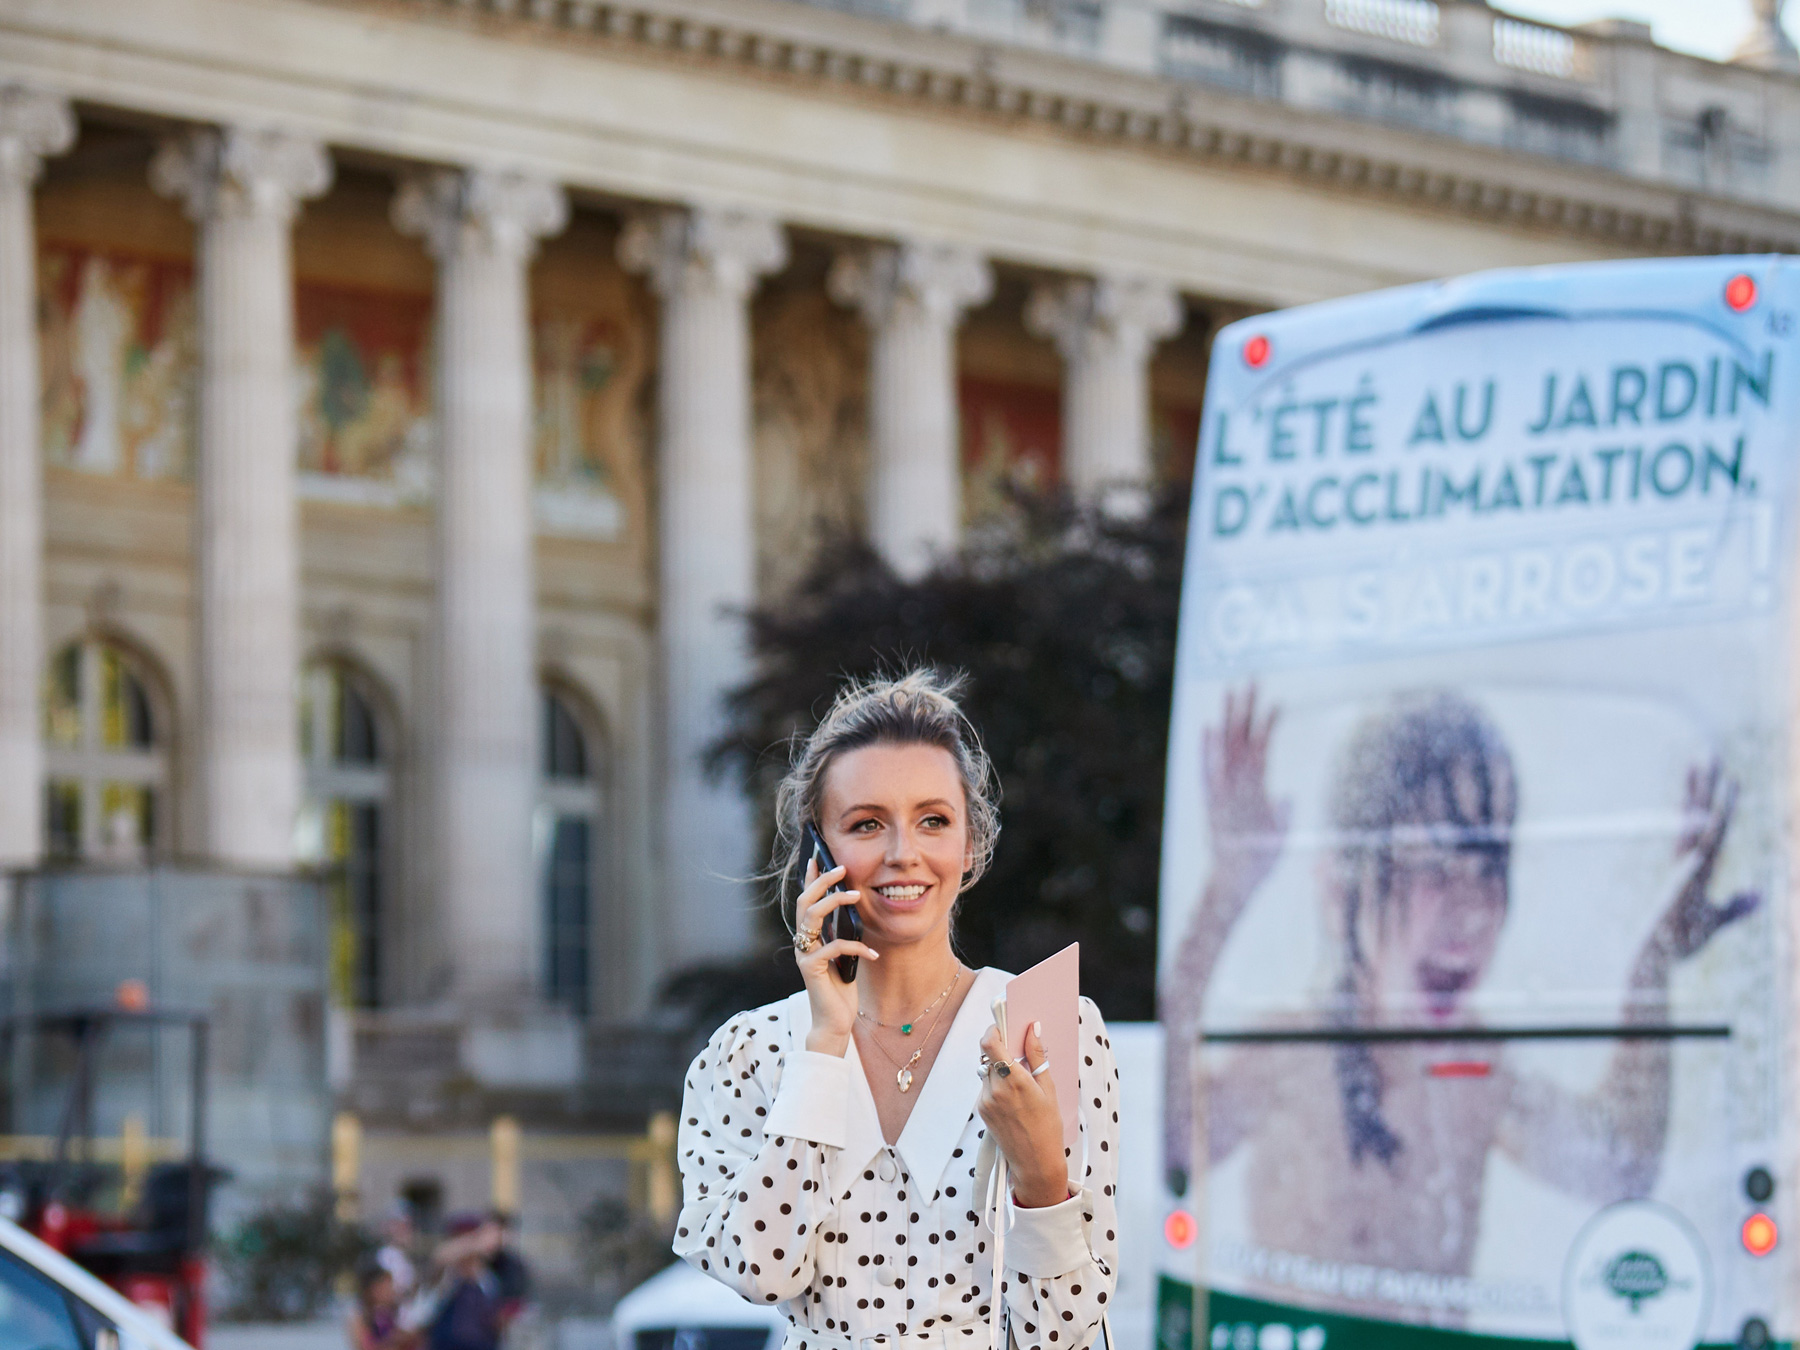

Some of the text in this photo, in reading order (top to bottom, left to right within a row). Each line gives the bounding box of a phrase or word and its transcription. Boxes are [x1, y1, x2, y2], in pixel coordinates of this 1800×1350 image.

[1211, 350, 1775, 466] L'ÉTÉ AU JARDIN
[1344, 526, 1711, 636] S'ARROSE
